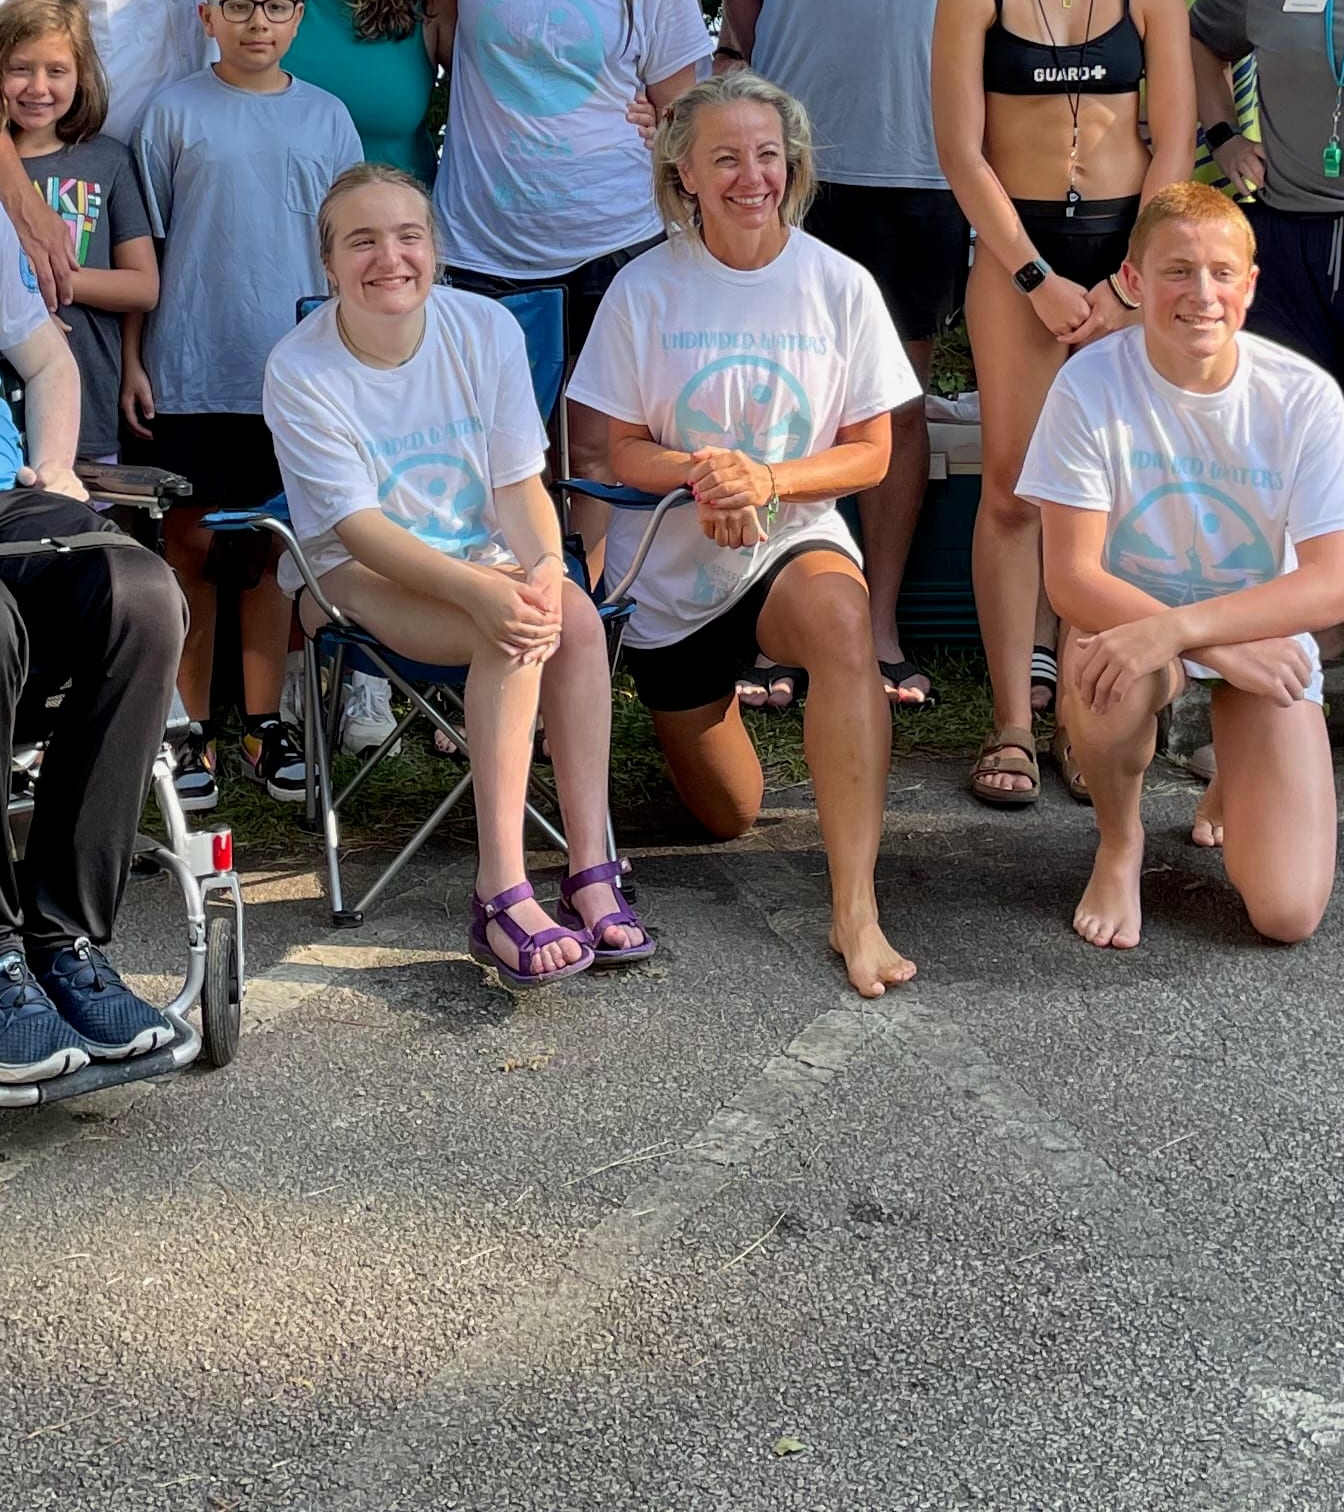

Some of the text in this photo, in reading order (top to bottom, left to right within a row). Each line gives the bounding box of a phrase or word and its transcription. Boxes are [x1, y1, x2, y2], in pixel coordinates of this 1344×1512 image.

[1033, 66, 1090, 83] GUARD
[661, 331, 828, 356] UNDIVIDED WATERS
[428, 415, 484, 444] WATER
[1210, 460, 1284, 490] WATERS
